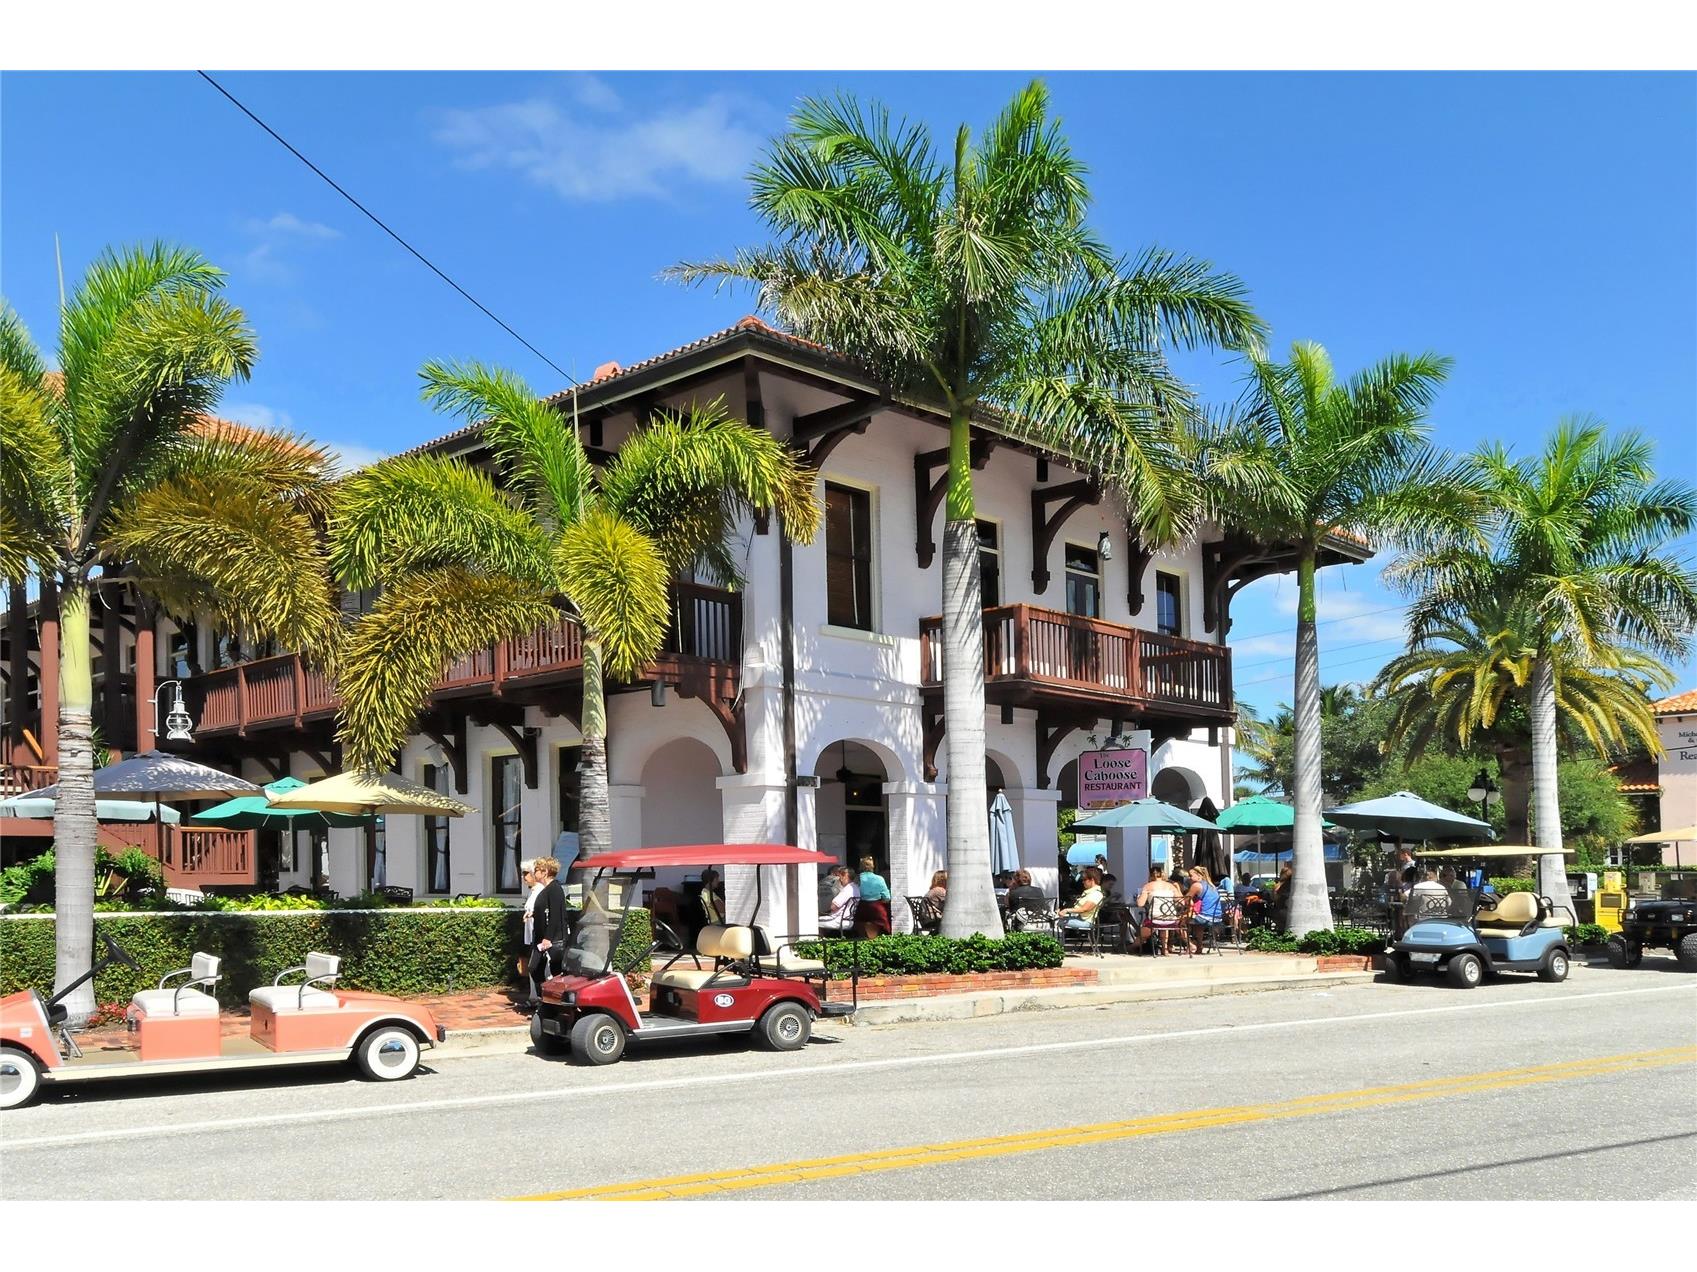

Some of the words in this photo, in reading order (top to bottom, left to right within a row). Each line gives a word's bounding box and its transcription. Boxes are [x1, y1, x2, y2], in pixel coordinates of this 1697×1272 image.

[1094, 759, 1131, 769] Loose
[1085, 770, 1137, 781] Caboose
[1085, 782, 1142, 791] RESTAURANT
